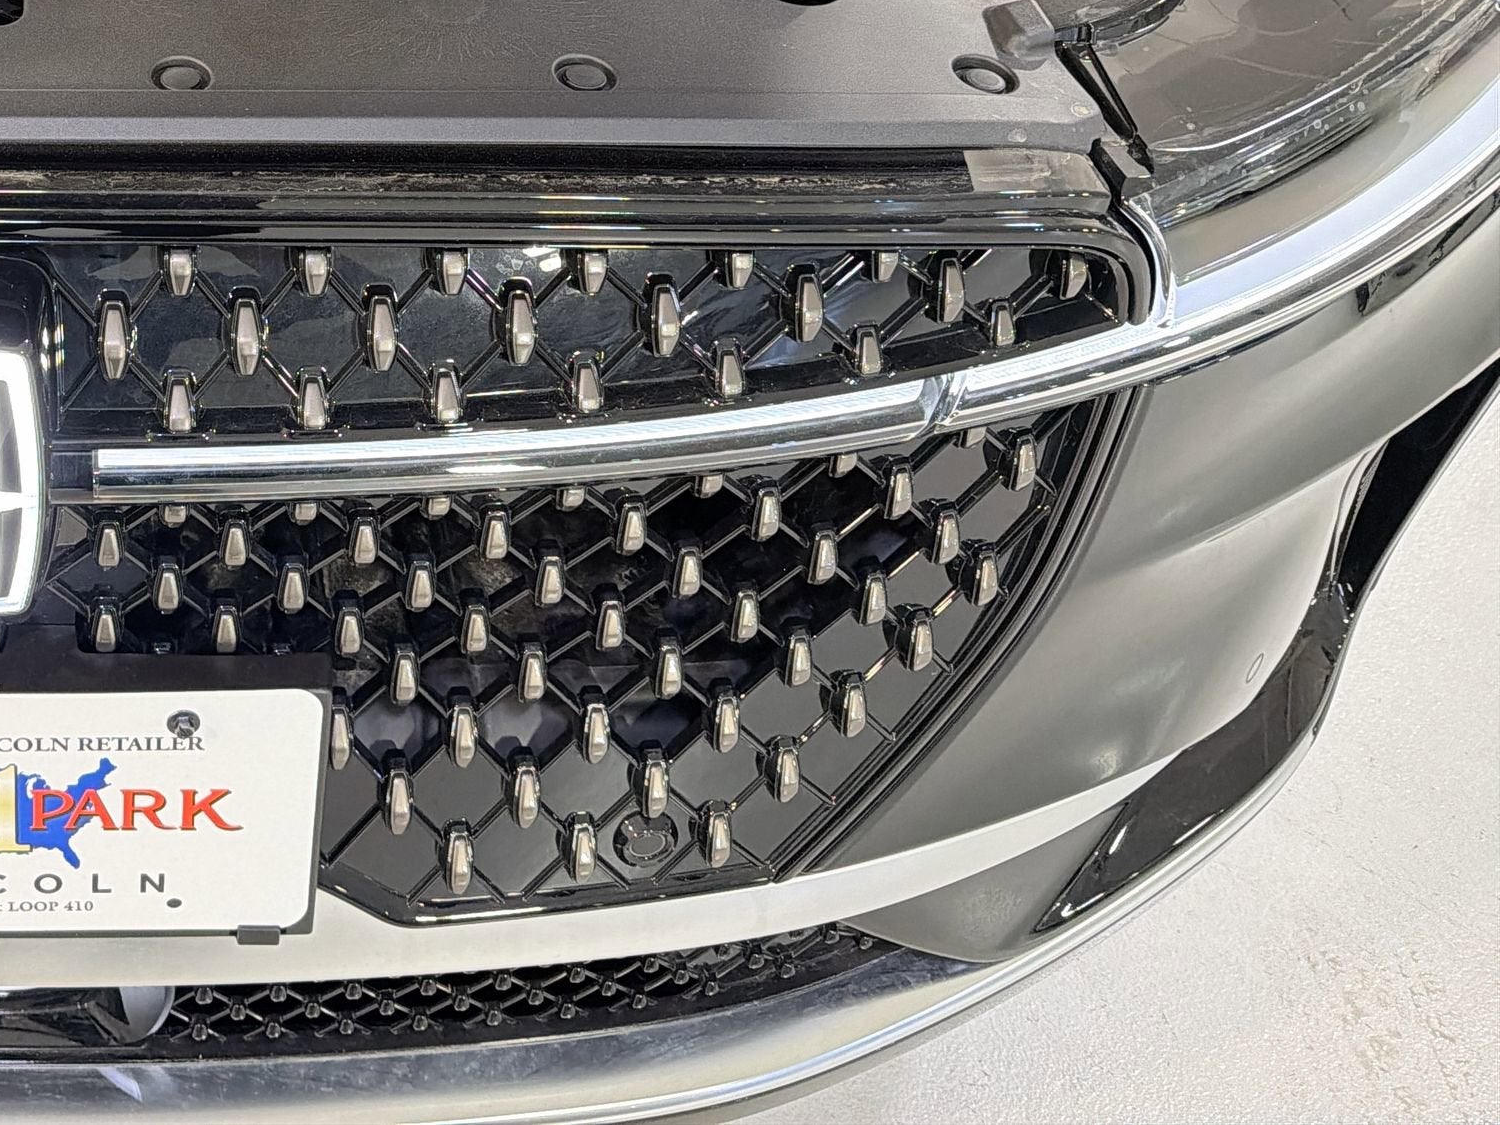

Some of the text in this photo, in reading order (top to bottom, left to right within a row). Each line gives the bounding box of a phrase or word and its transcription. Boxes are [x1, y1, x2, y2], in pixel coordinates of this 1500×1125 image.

[77, 735, 205, 752] RETAILER
[29, 788, 244, 832] PARK
[8, 900, 59, 912] LOOP
[64, 900, 95, 912] 410
